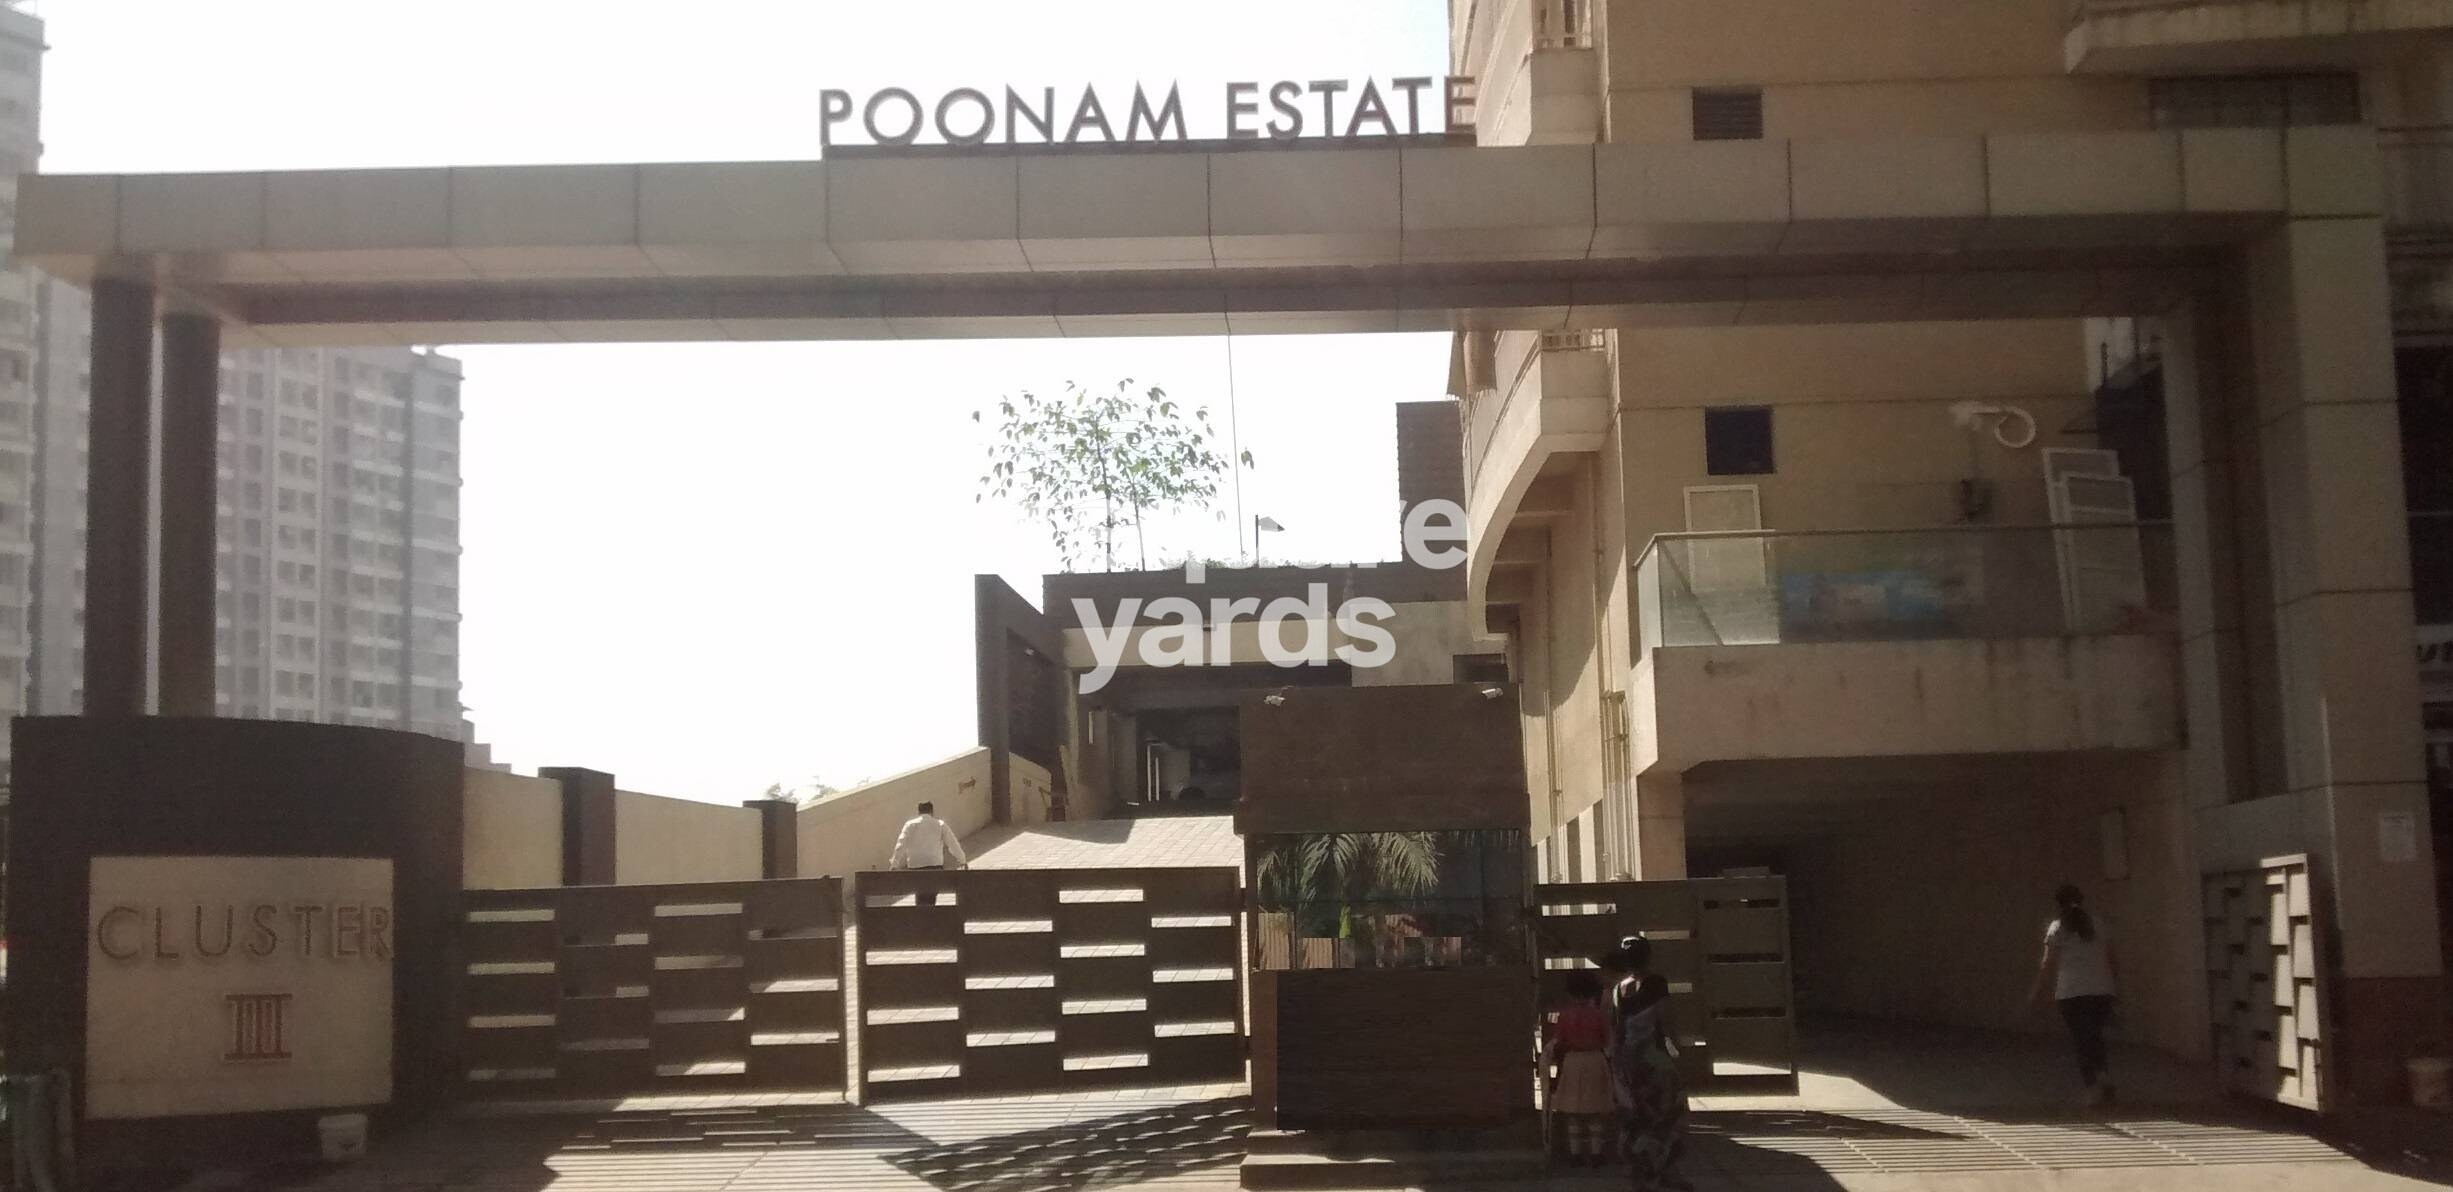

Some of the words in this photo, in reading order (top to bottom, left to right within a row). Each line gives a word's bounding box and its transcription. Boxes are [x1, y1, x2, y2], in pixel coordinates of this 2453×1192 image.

[819, 79, 1189, 147] POONAM
[1226, 75, 1476, 140] ESTATE
[98, 904, 391, 960] CLUSTER
